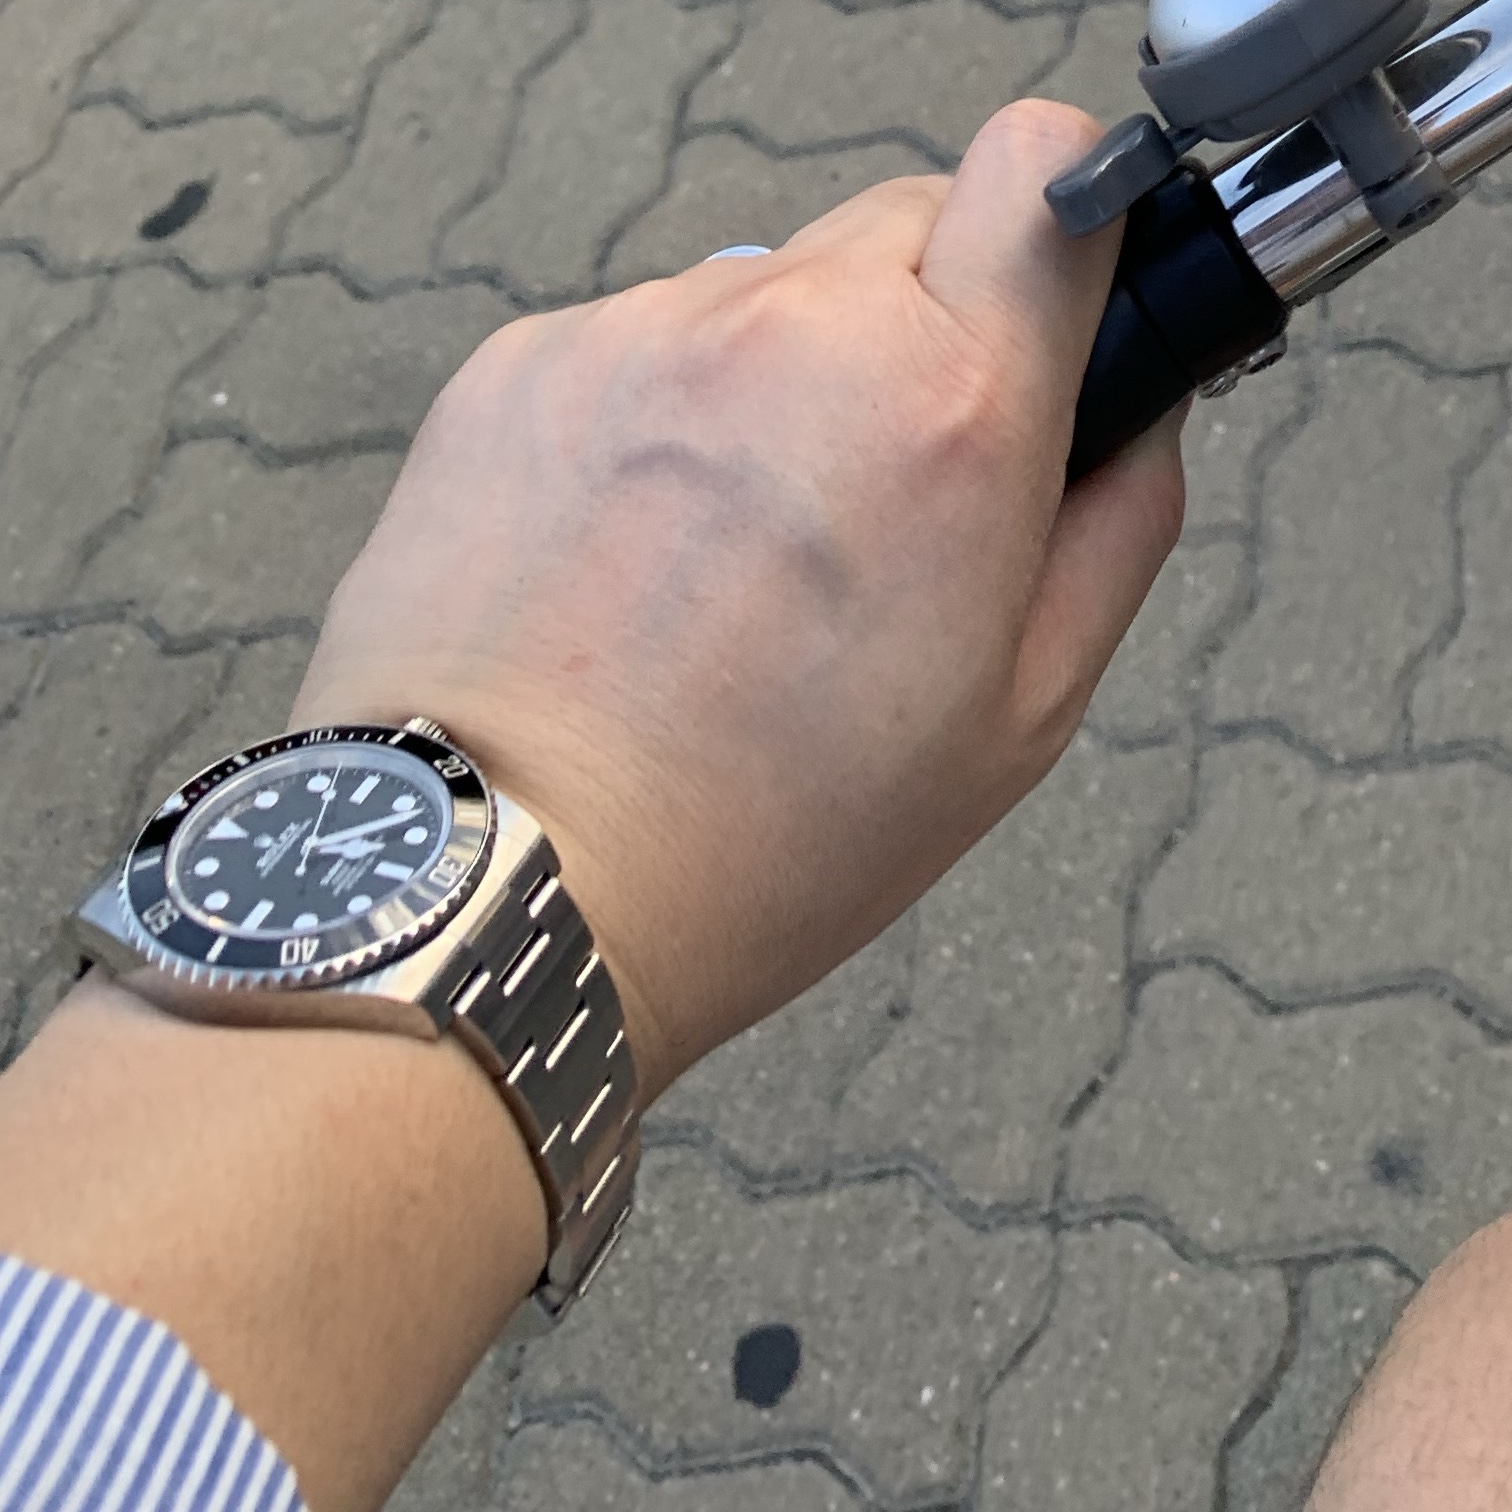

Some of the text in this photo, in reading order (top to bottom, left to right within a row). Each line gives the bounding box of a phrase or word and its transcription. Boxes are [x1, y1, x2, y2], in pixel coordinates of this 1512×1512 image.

[433, 754, 470, 779] 20
[142, 898, 181, 936] 50
[280, 937, 320, 967] 40
